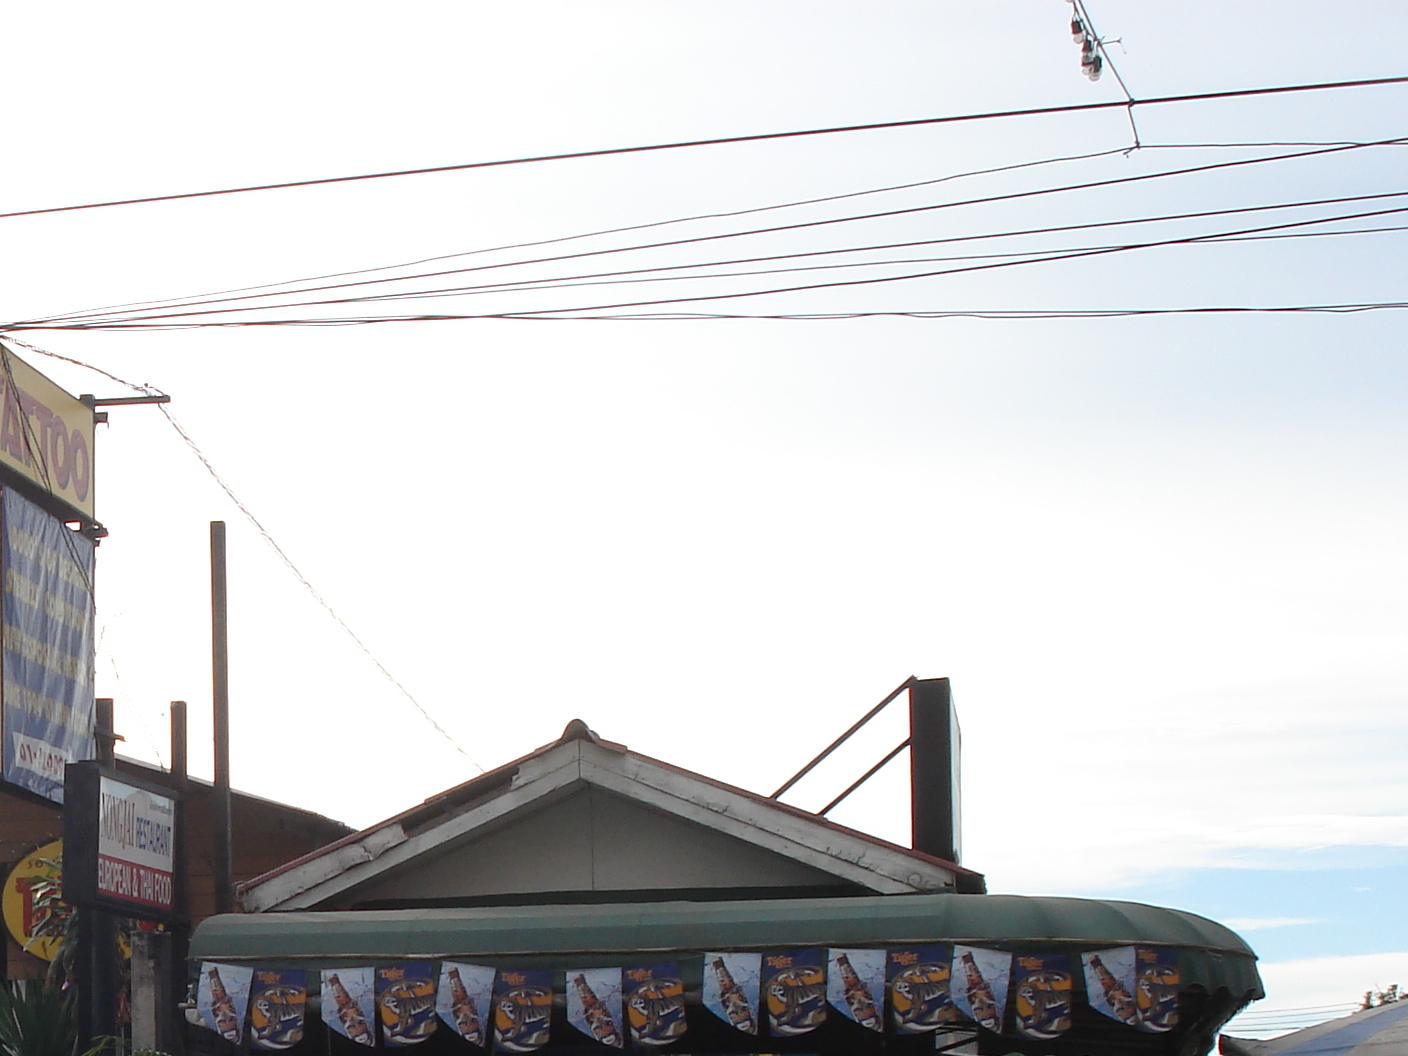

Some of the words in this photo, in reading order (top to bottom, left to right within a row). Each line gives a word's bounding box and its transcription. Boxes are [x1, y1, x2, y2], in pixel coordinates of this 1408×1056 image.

[98, 857, 132, 897] EUROPEAN
[132, 865, 139, 899] &
[154, 872, 172, 906] FOOD
